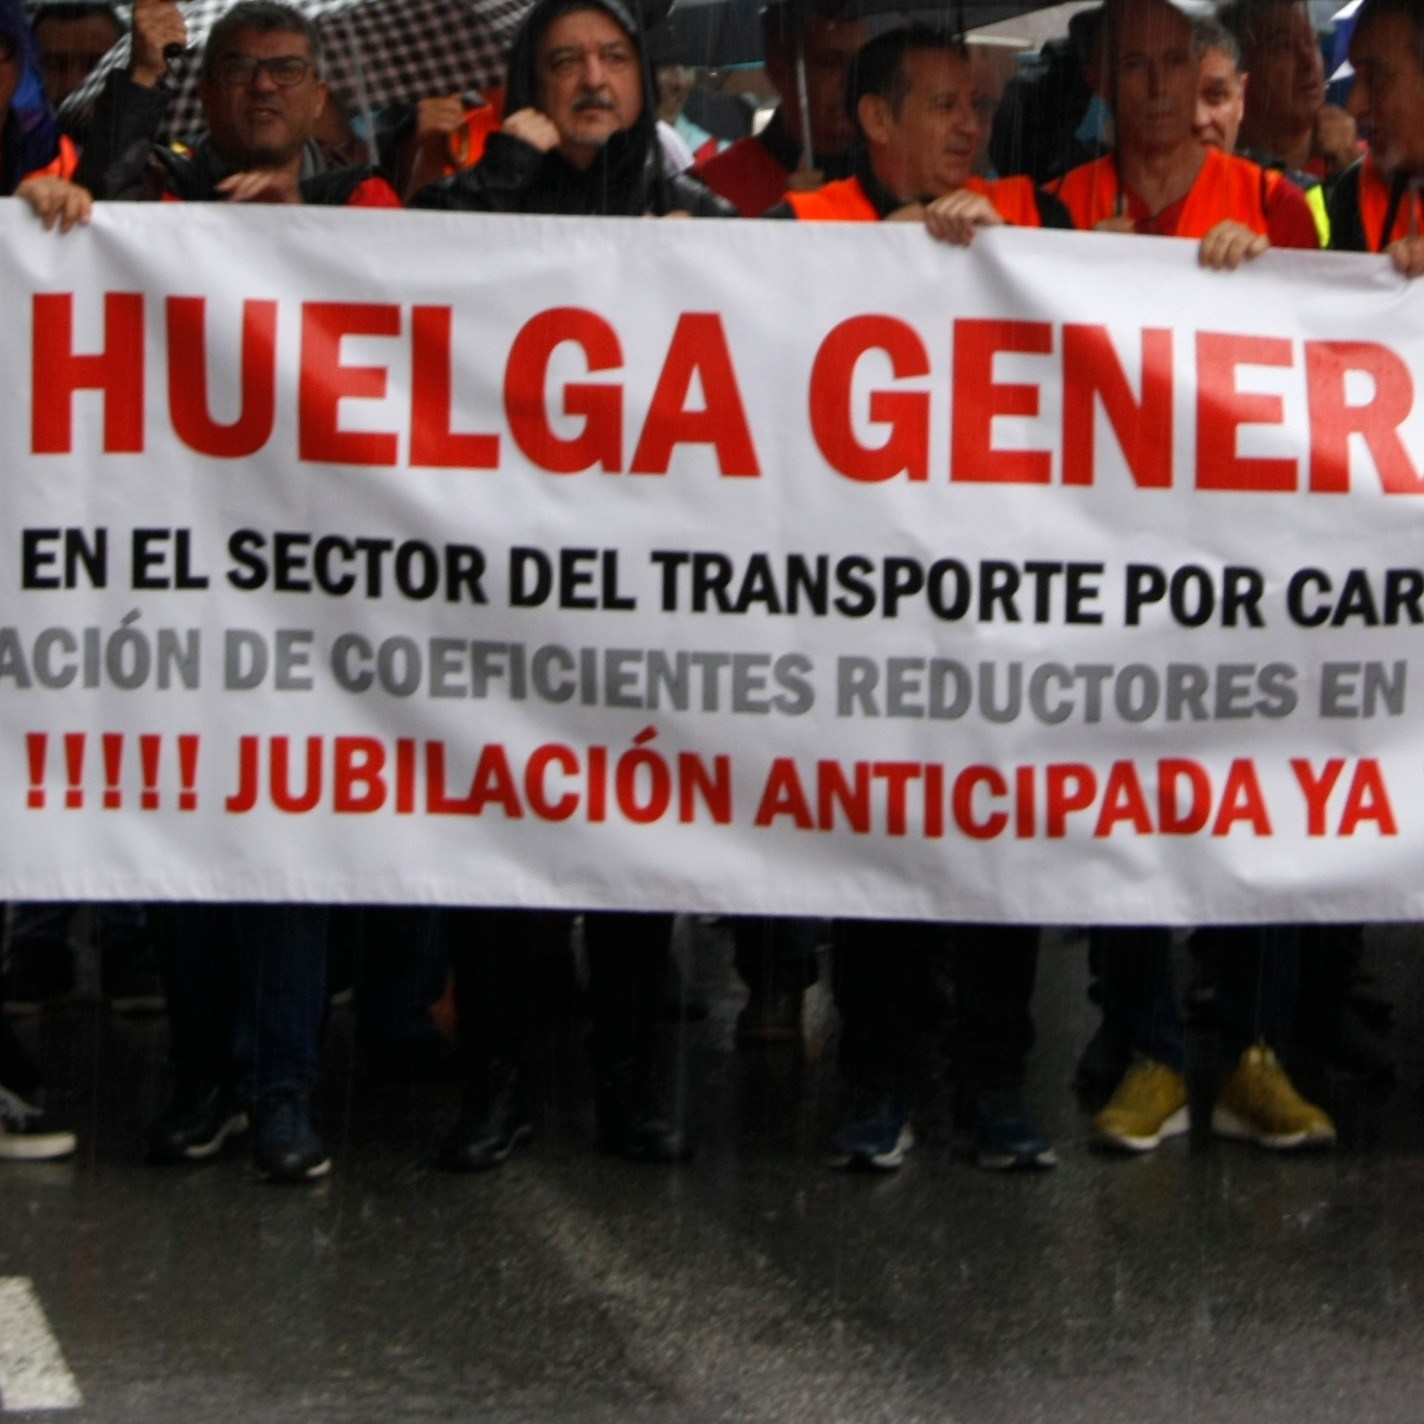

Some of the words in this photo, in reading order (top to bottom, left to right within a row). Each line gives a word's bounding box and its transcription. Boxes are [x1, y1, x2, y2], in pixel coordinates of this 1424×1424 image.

[32, 292, 761, 478] HUELGA
[22, 528, 107, 590] EN
[132, 529, 209, 590] EL
[227, 529, 489, 605] SECTOR
[509, 547, 636, 611] DEL
[651, 551, 1103, 625] TRANSPORTE
[1125, 565, 1265, 628] POR
[223, 629, 315, 692] DE
[325, 633, 814, 717] COEFICIENTES
[837, 656, 1298, 721] REDUCTORES
[1318, 661, 1407, 720] EN
[27, 733, 199, 811] !!!!!
[227, 728, 731, 824] JUBILACIÓN
[757, 758, 1273, 840] ANTICIPADA
[1292, 759, 1398, 837] YA
